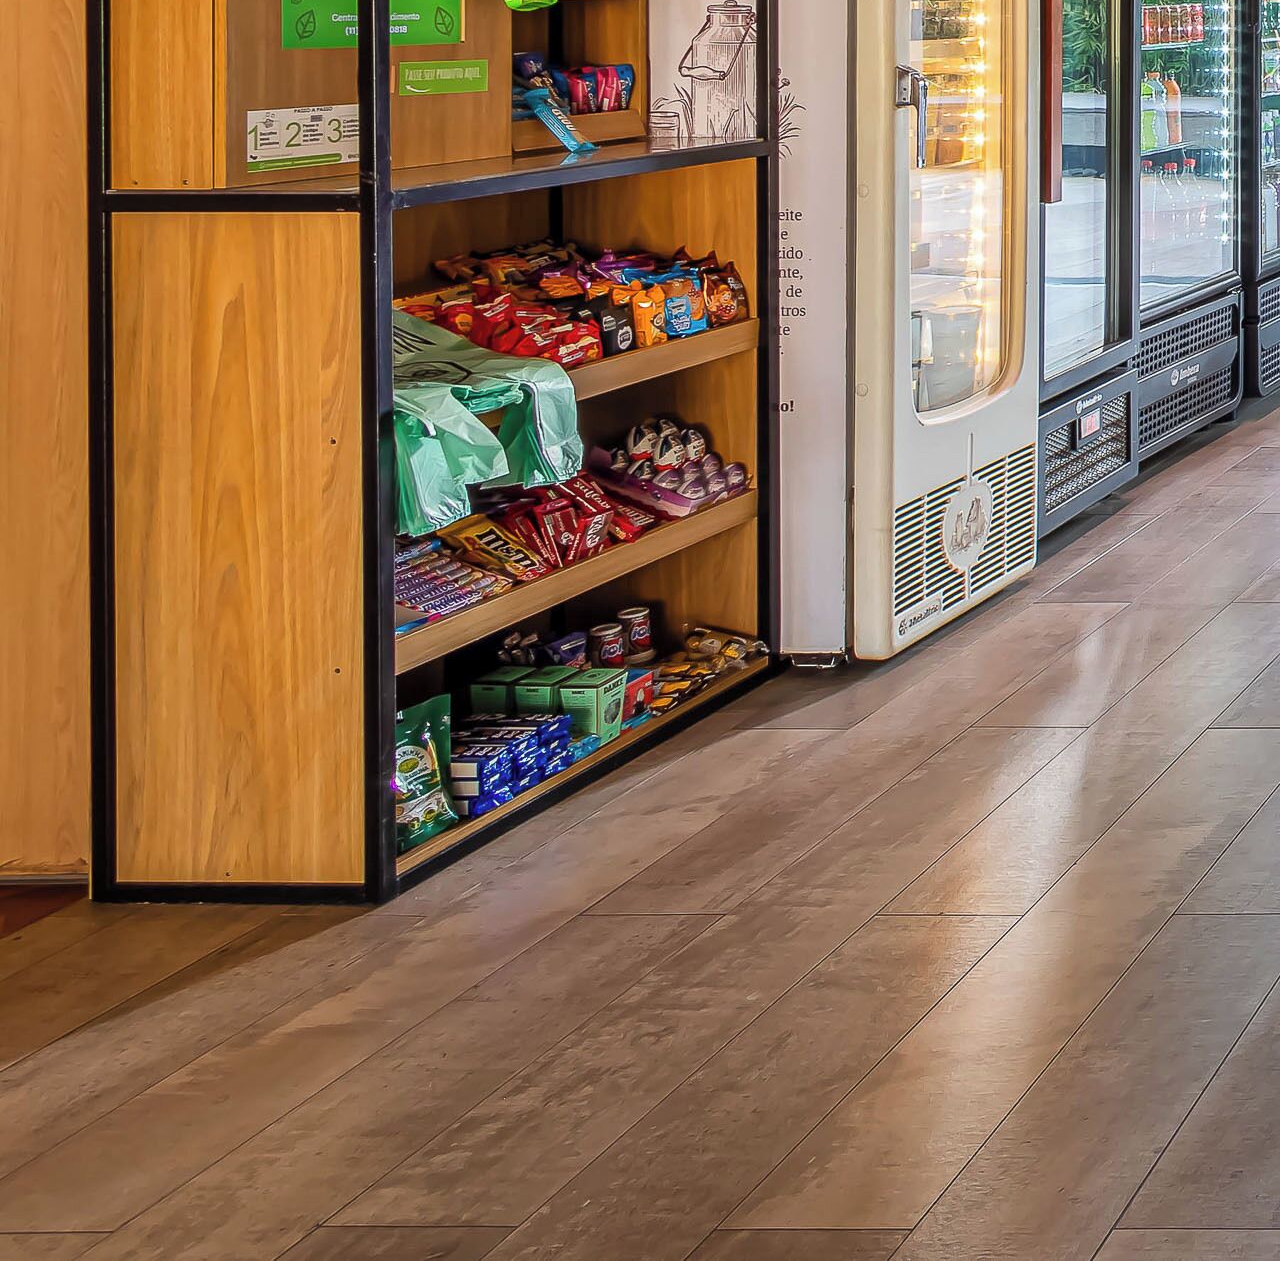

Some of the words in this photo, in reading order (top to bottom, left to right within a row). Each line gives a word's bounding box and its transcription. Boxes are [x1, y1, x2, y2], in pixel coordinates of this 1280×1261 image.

[248, 125, 259, 150] 1
[285, 122, 301, 148] 2
[327, 119, 342, 143] 3
[785, 284, 803, 298] de
